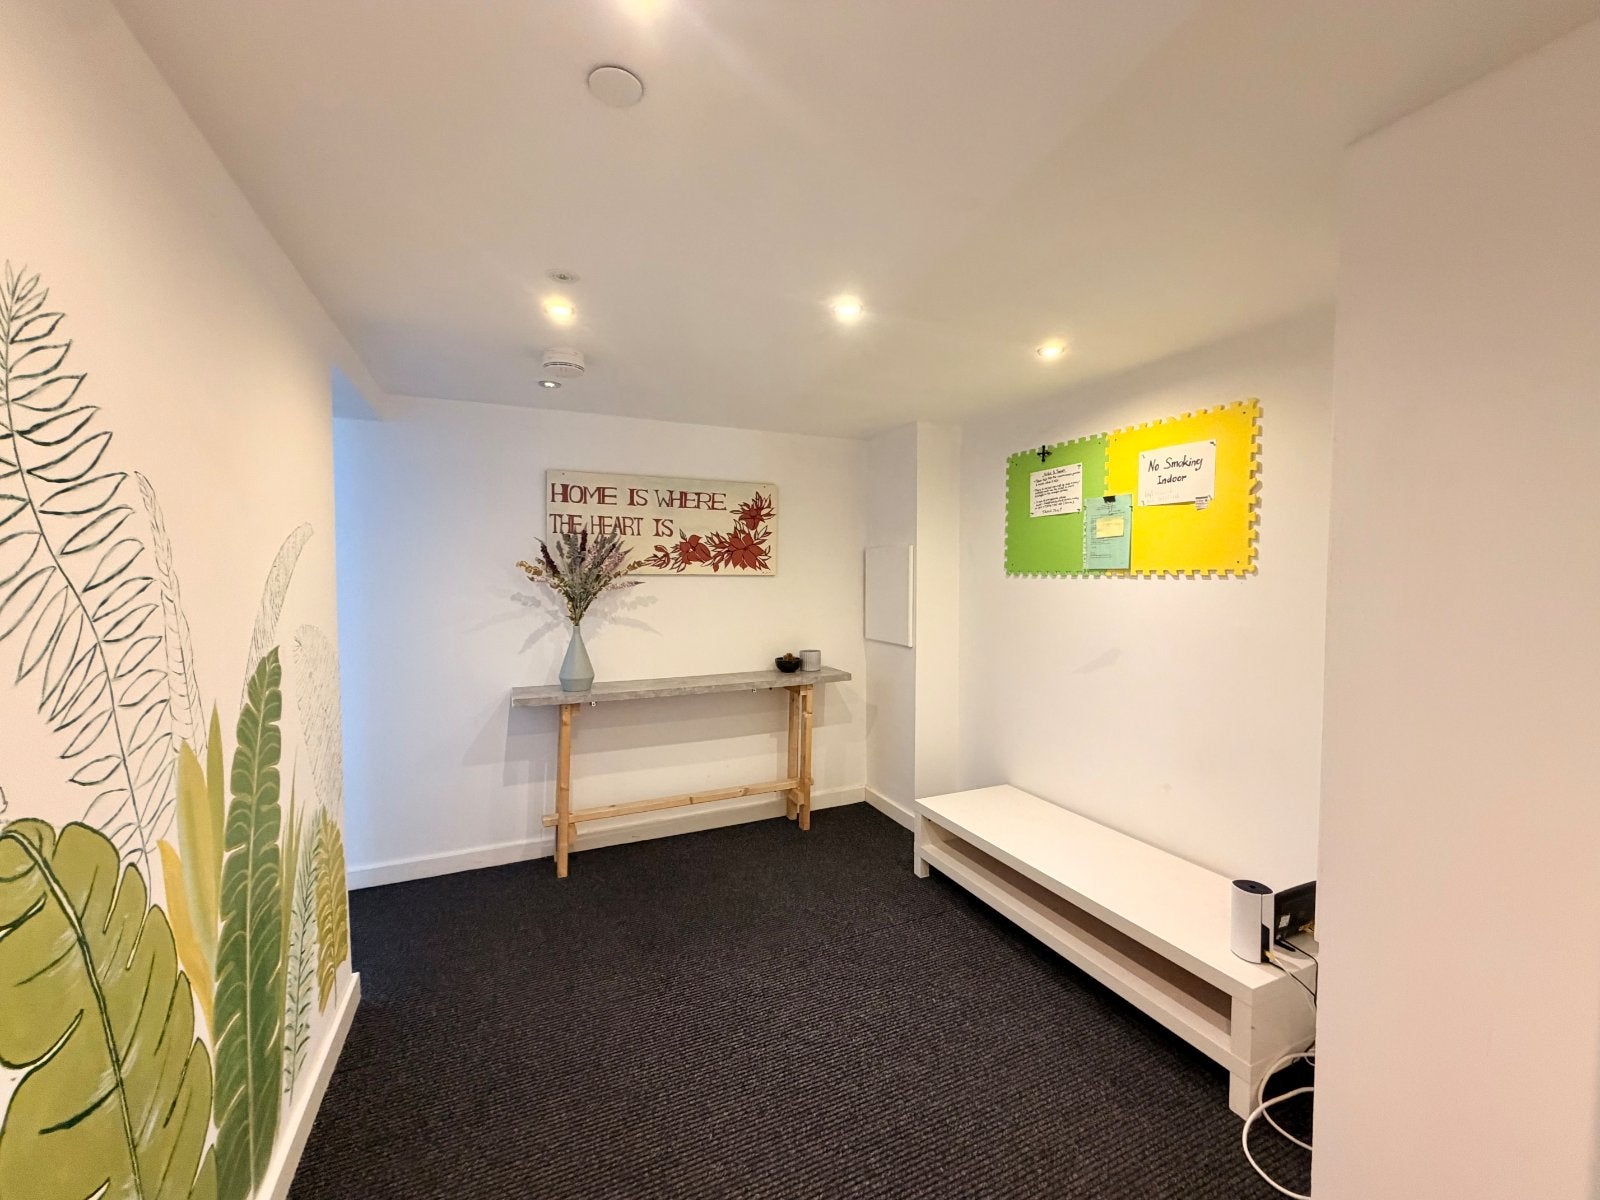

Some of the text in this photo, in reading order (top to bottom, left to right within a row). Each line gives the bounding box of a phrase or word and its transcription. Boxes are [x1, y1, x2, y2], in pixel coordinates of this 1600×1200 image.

[1148, 455, 1203, 472] No Smoking
[1157, 474, 1187, 485] Indoor
[550, 483, 727, 511] HOME IS WHERE
[549, 513, 674, 538] THE HEART IS
